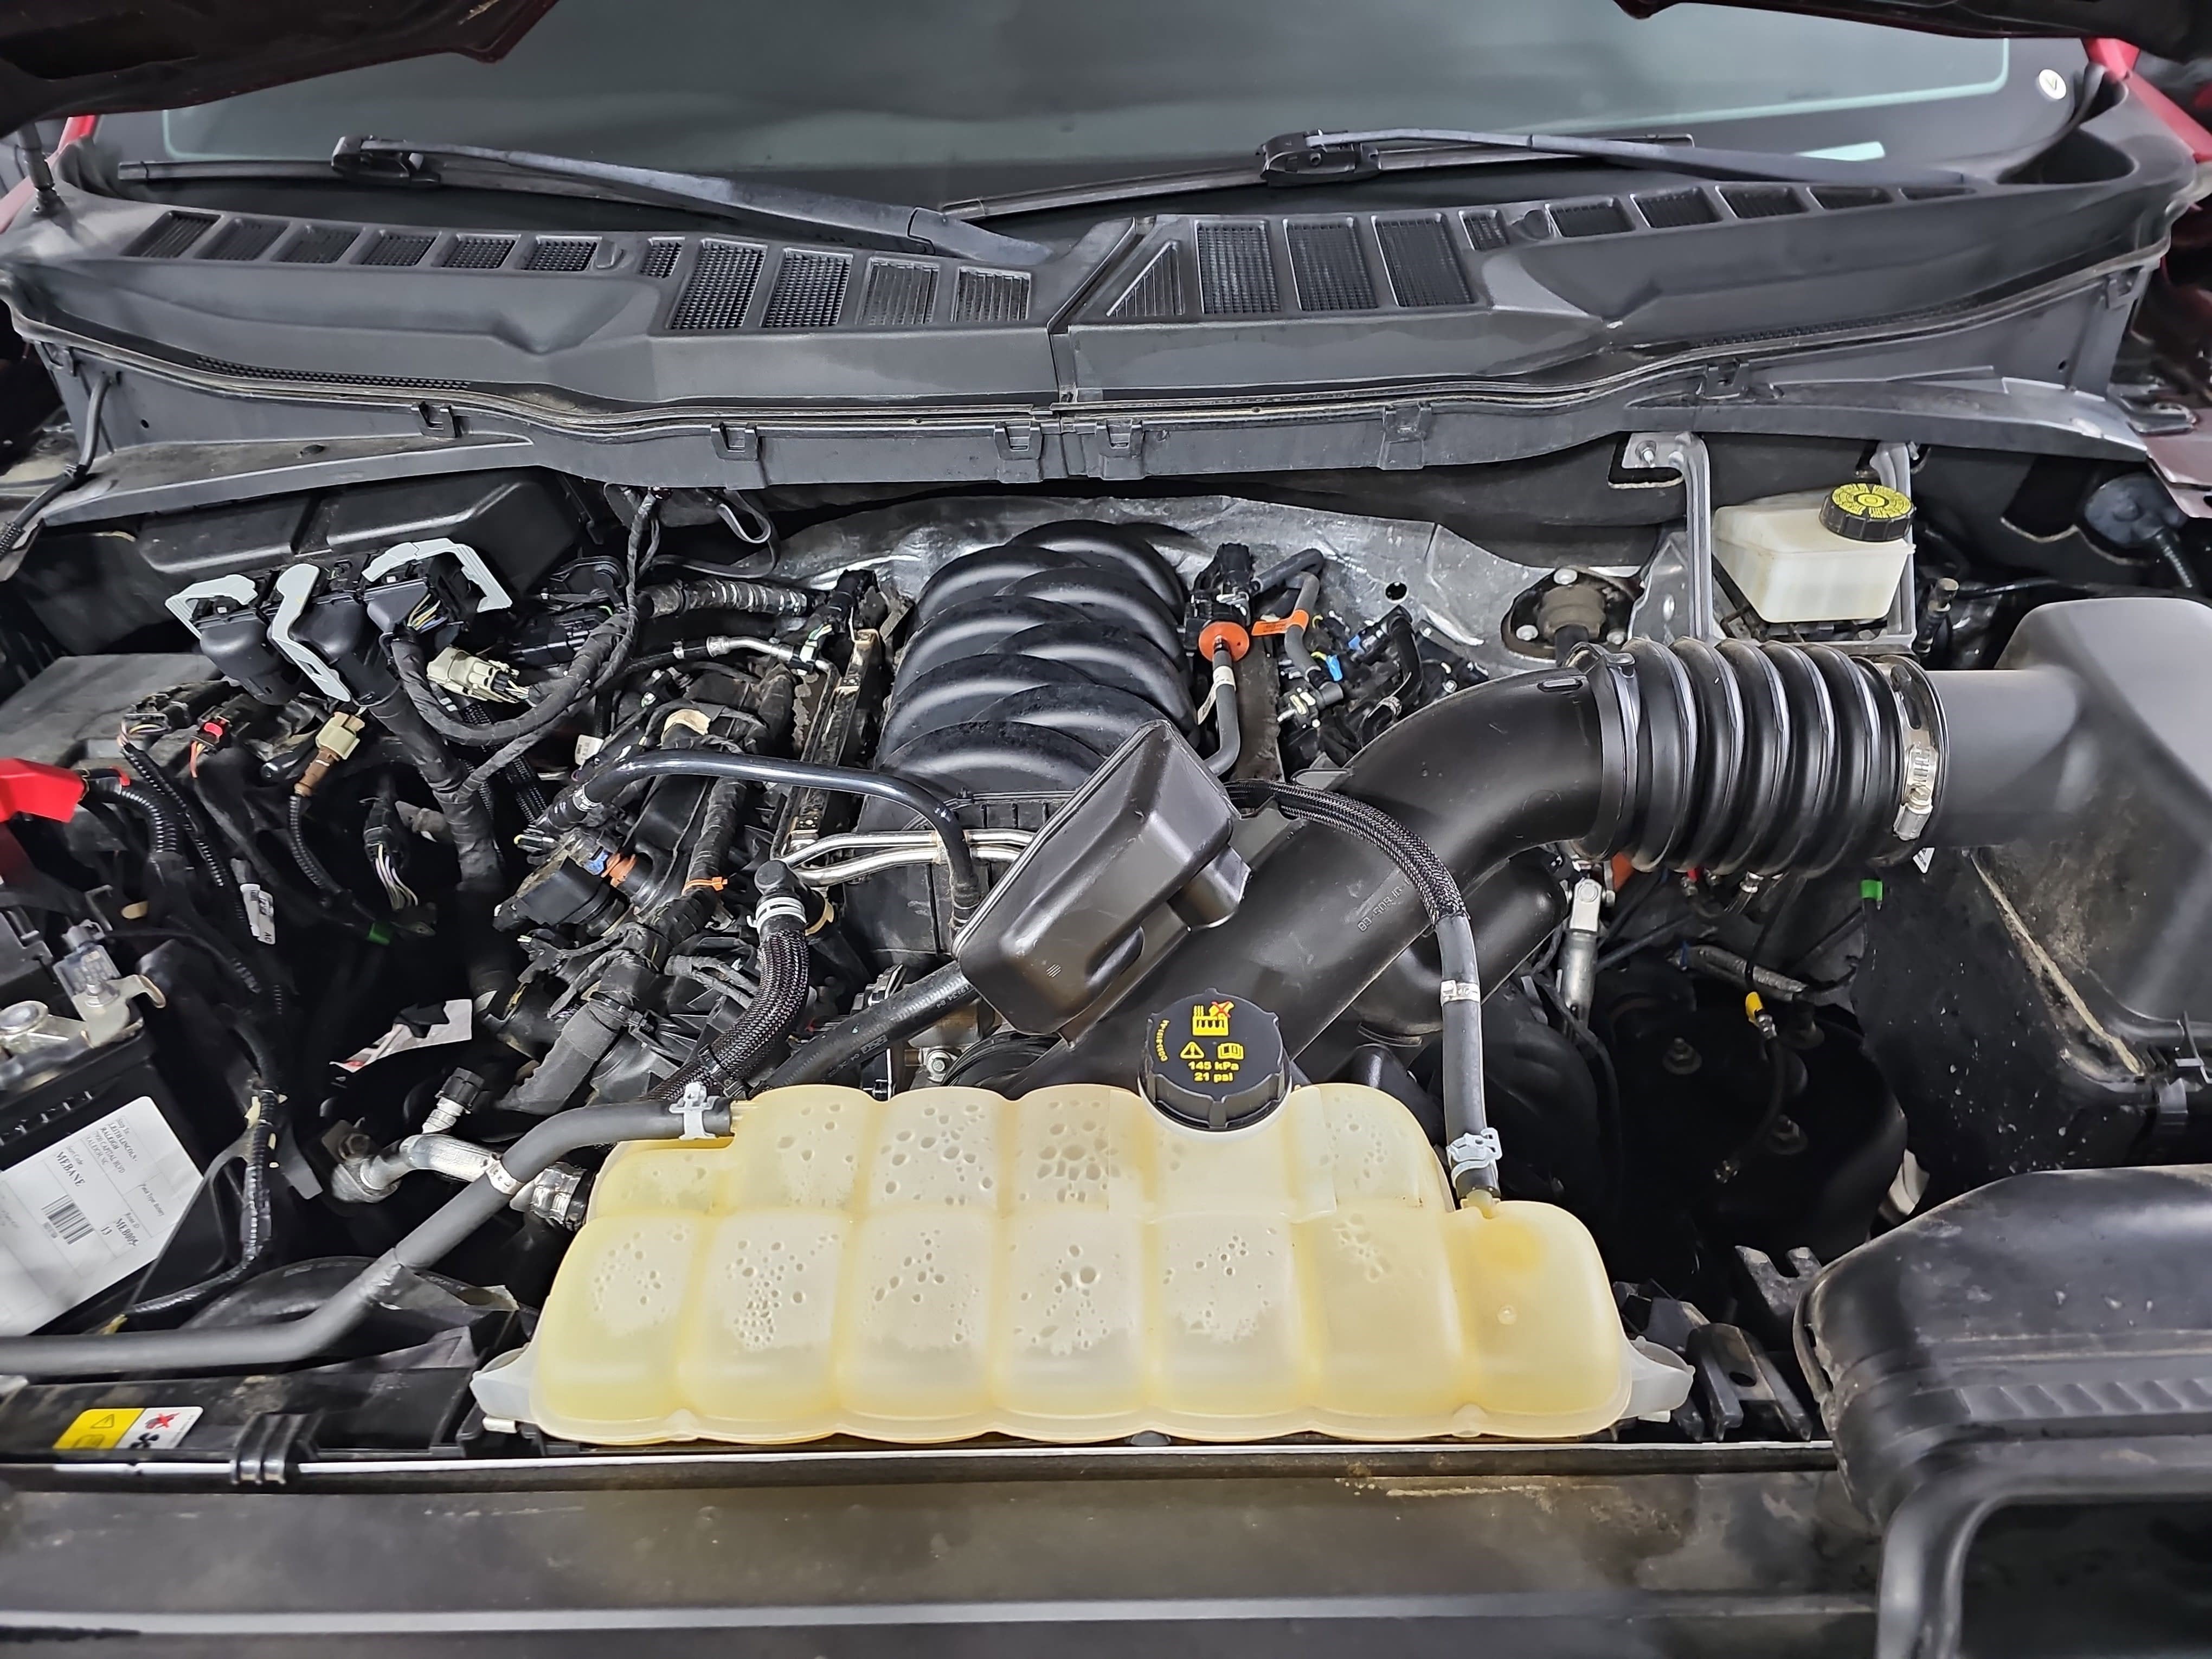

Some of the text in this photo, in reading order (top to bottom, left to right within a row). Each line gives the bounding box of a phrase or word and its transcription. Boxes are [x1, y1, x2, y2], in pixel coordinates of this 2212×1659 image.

[1187, 1062, 1239, 1071] 145 kPa
[1194, 1072, 1233, 1083] 21 psi
[100, 1126, 119, 1149] RALEIGH
[56, 1151, 85, 1187] MEBANE
